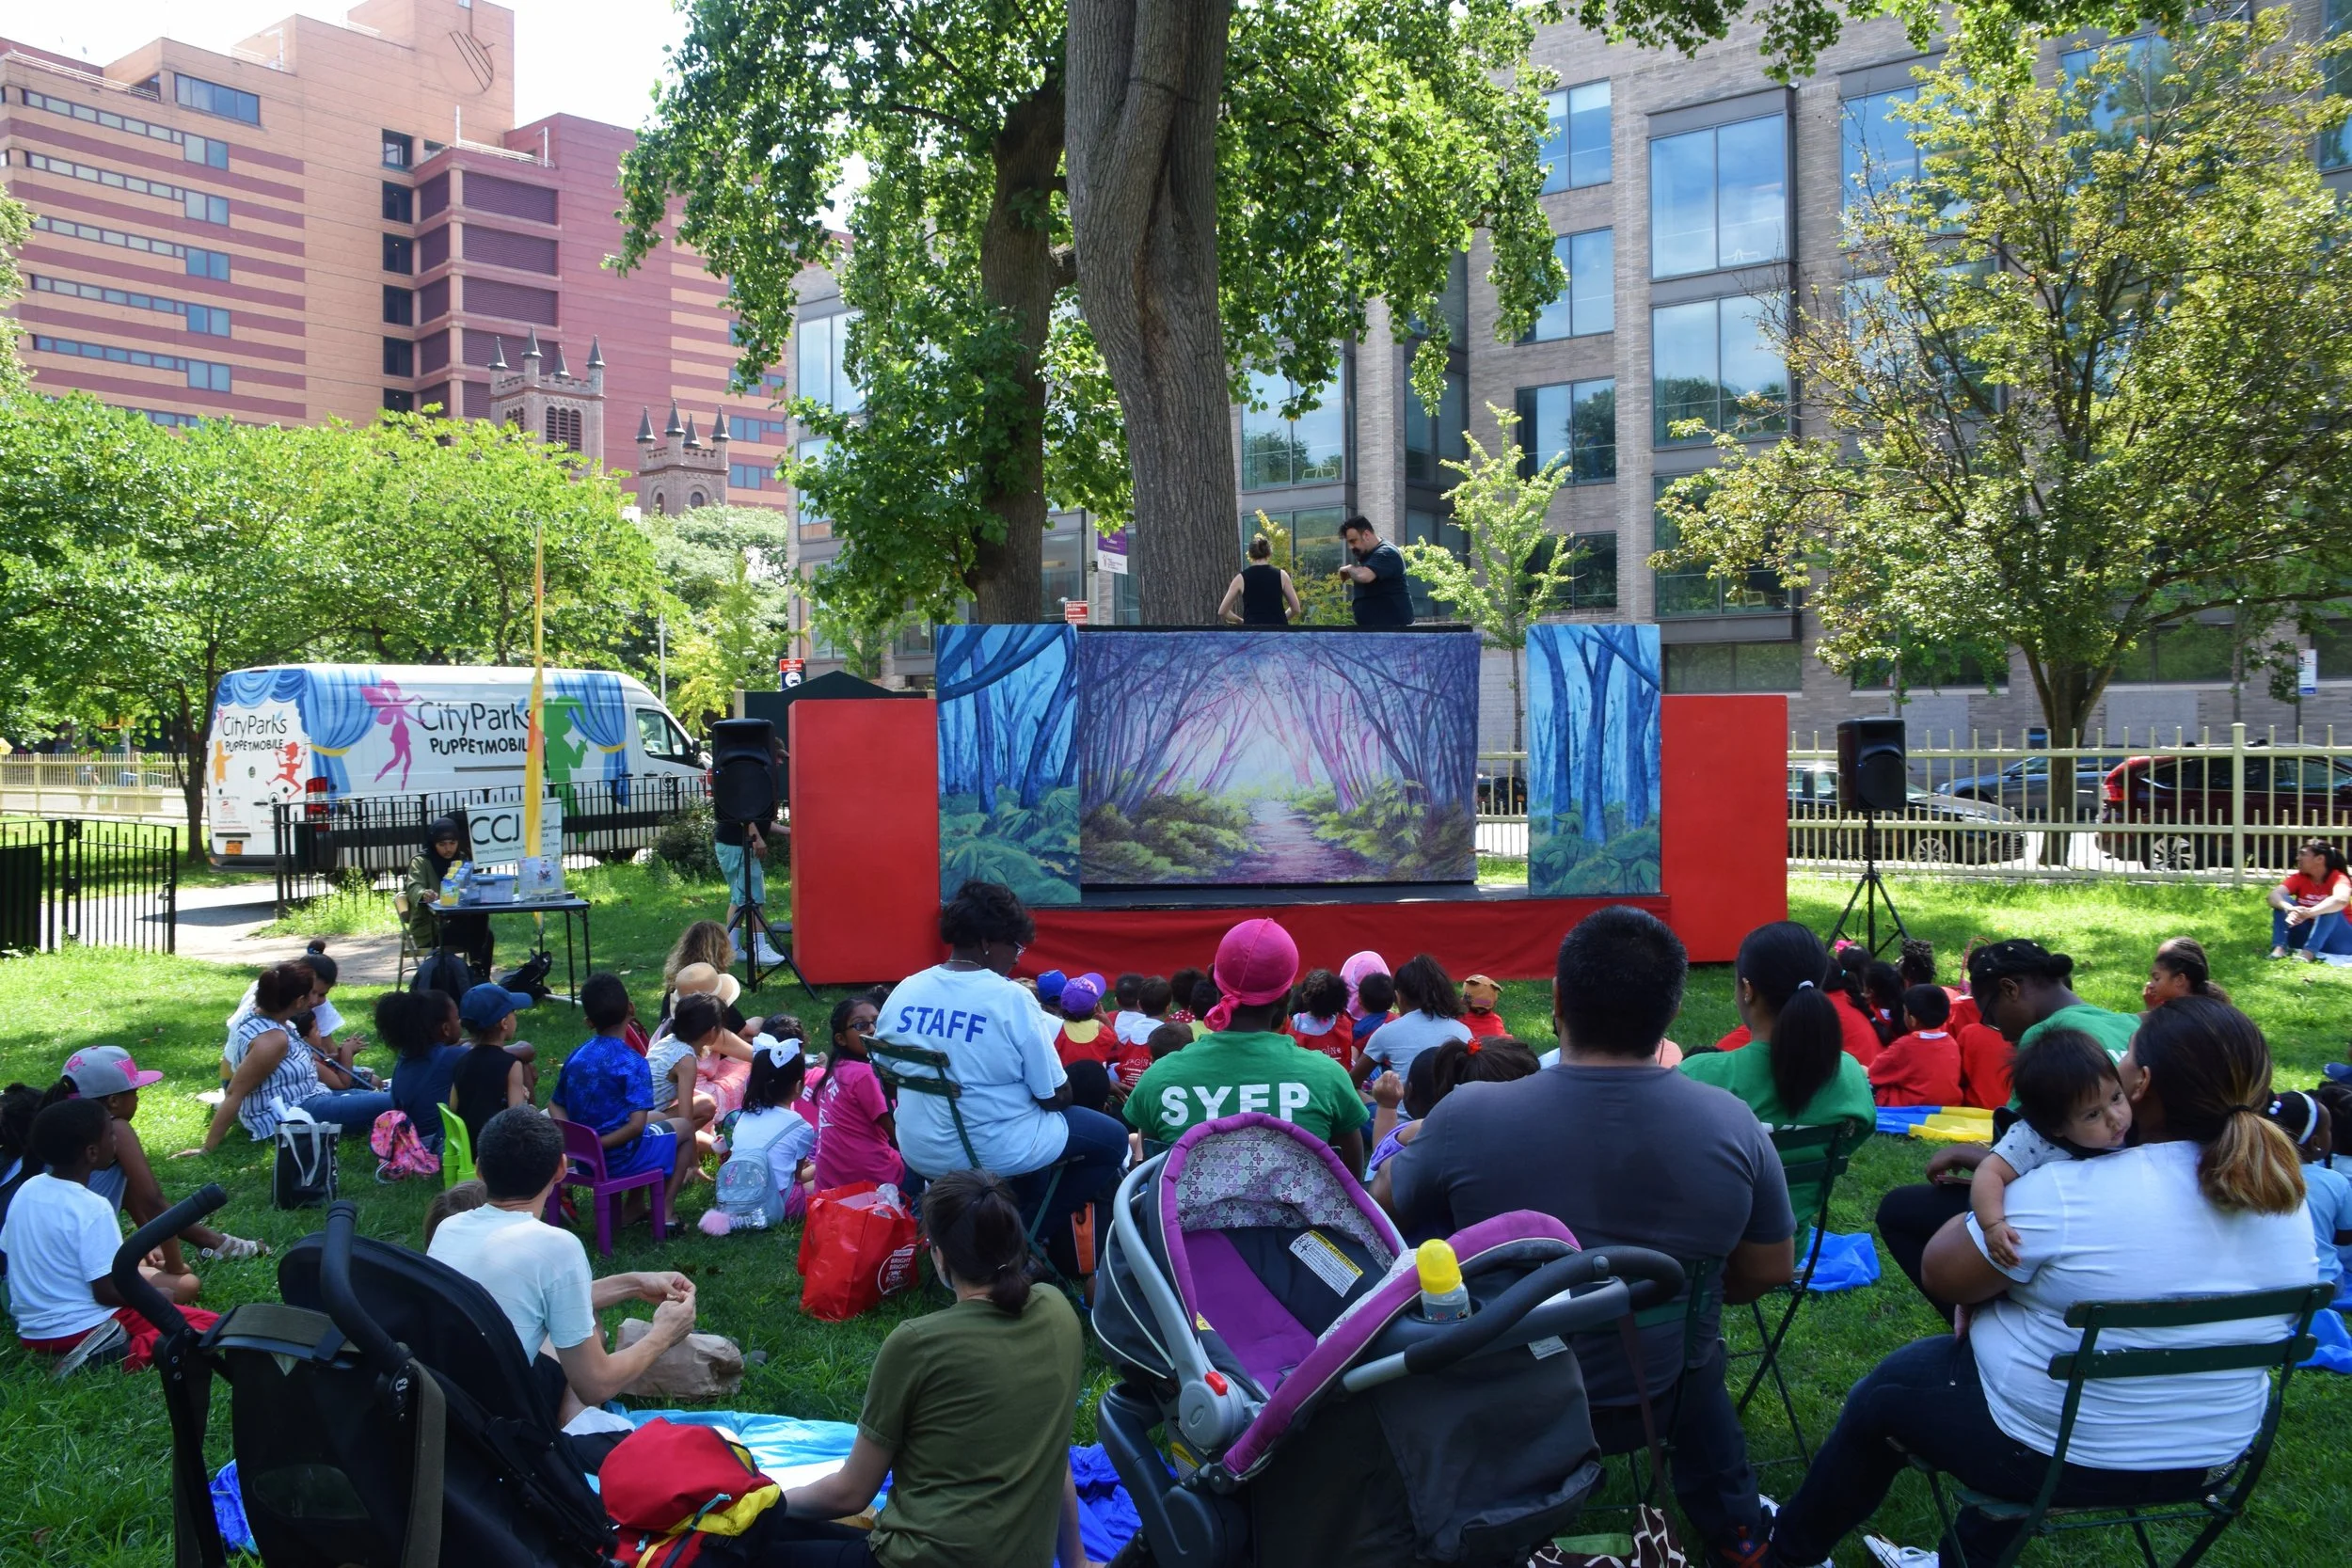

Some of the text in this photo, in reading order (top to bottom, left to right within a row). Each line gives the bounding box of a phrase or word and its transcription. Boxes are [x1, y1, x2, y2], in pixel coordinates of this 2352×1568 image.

[222, 715, 287, 737] CityParks
[225, 739, 283, 752] PUPPETMOBILE
[429, 737, 527, 755] PUPPETMOBIL
[470, 814, 520, 846] CCJ
[897, 1006, 988, 1043] STAFF
[1161, 1083, 1311, 1127] SYEP
[1332, 1247, 1360, 1274] ADVERTENCIA
